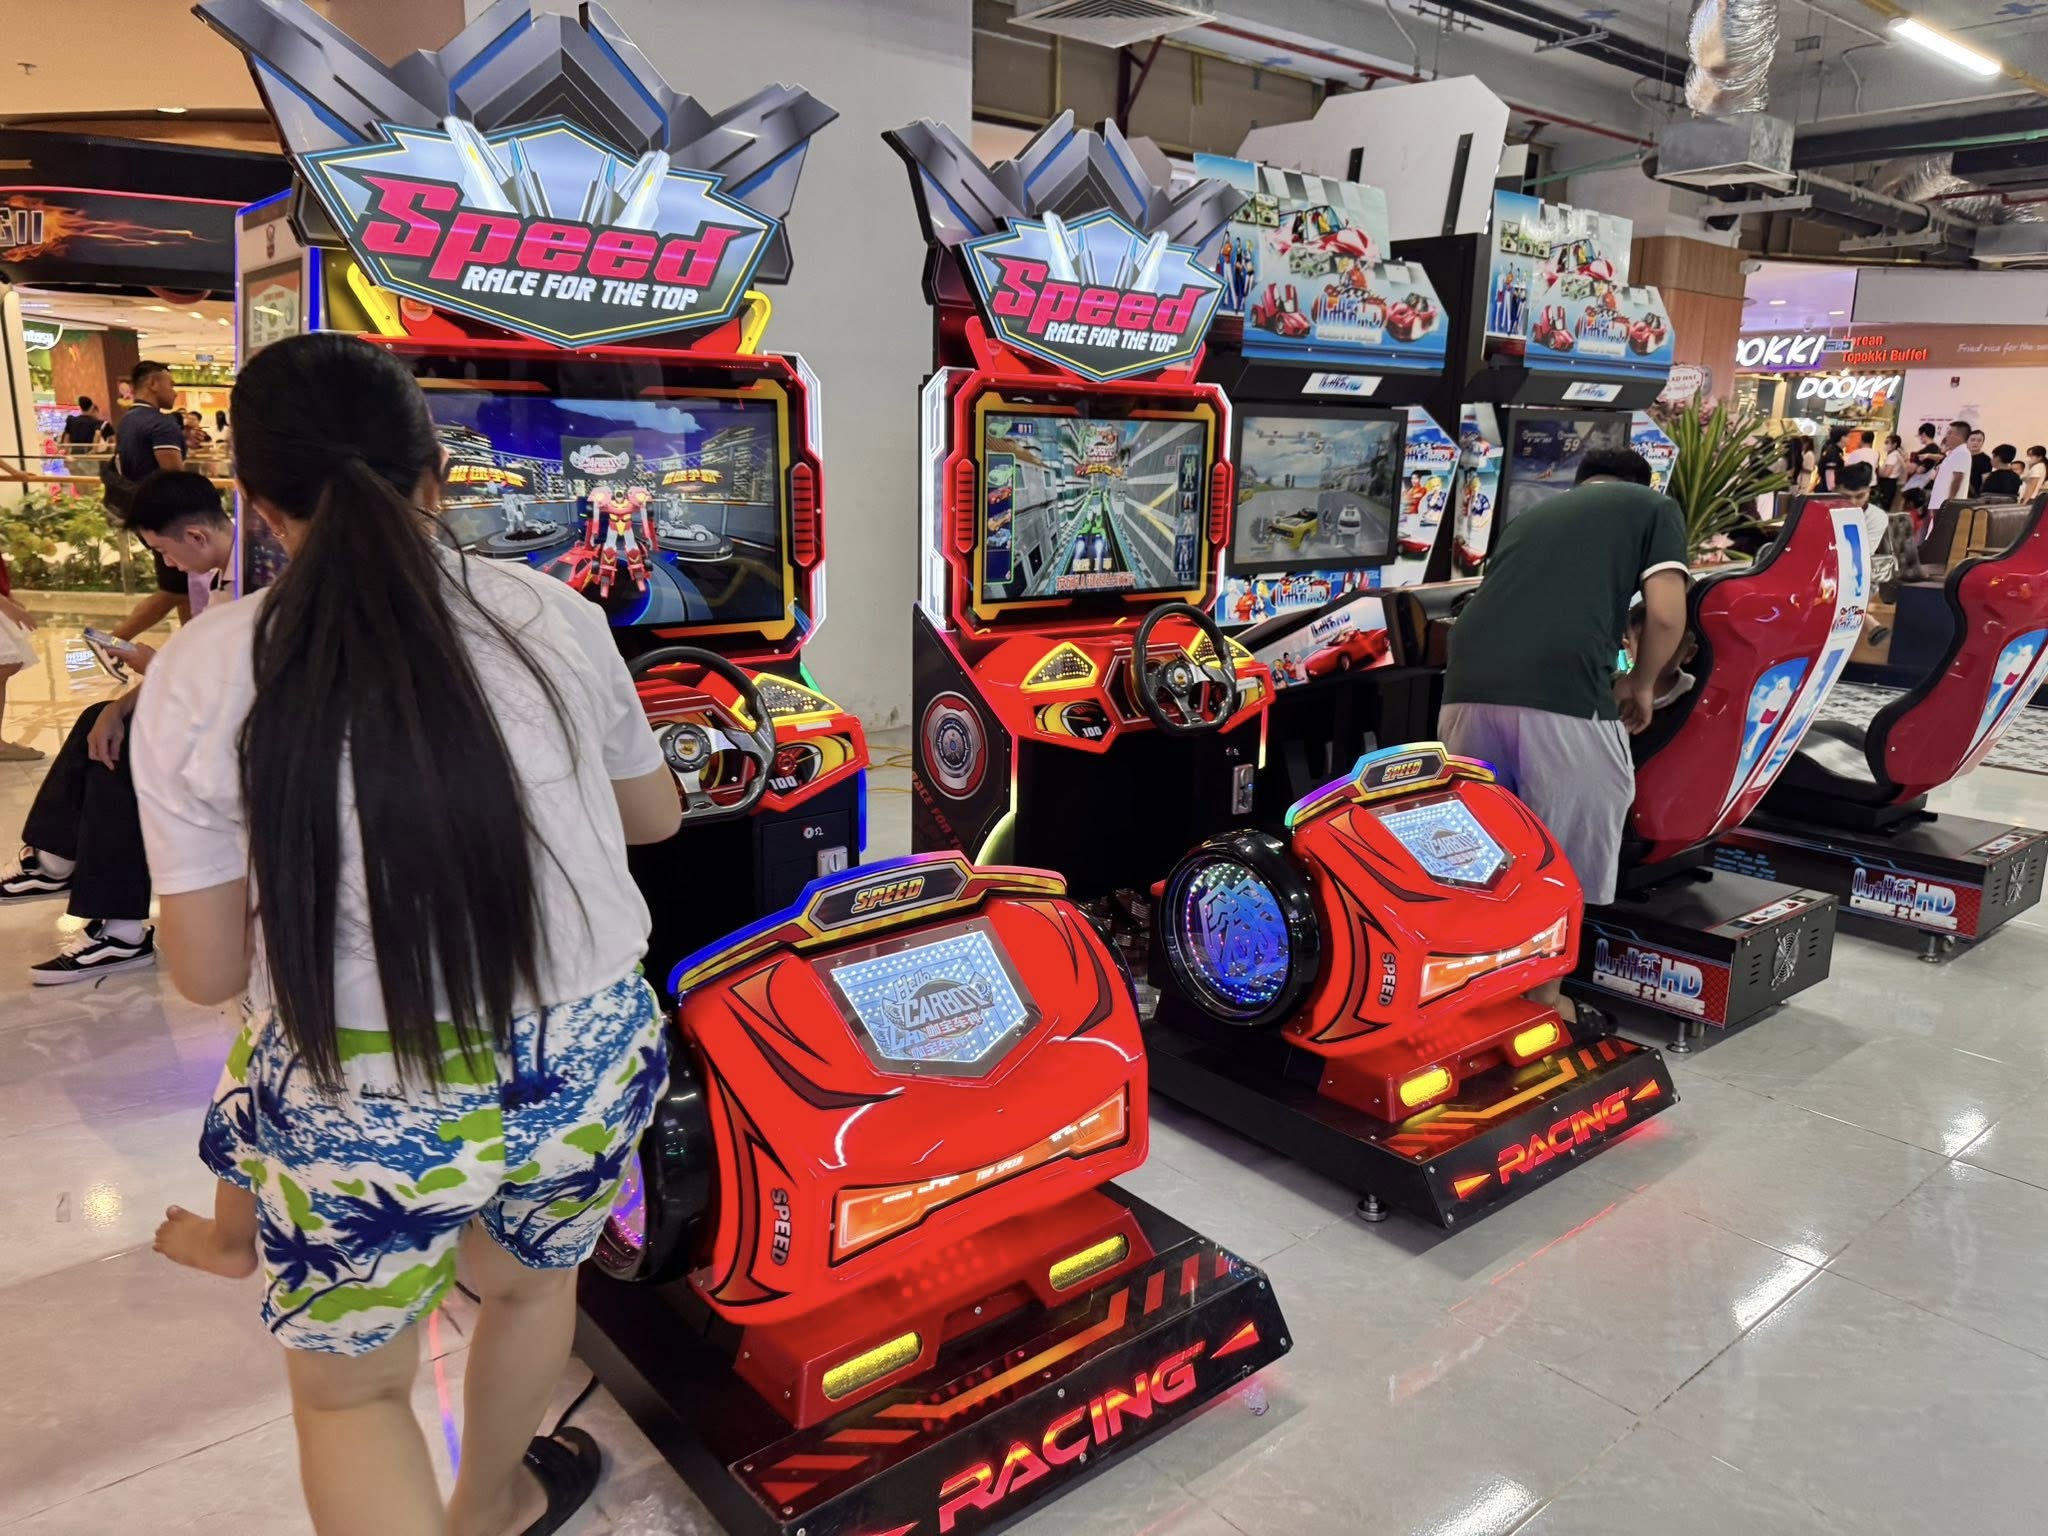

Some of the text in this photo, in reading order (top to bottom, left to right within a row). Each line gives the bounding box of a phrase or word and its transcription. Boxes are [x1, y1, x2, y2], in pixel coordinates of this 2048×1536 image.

[361, 175, 741, 286] Speed
[462, 266, 699, 312] RACE FOR THE TOP
[992, 257, 1206, 335] Speed
[1044, 321, 1178, 353] RACE FOR THE TOP
[1890, 348, 1928, 361] Buffet
[1796, 375, 1901, 400] DOOKKI
[1082, 726, 1103, 737] 100
[769, 776, 798, 790] 100
[1384, 759, 1424, 781] SPEED
[851, 876, 925, 915] SPEED
[1915, 881, 1957, 917] HD
[1378, 952, 1397, 1007] SPEED
[1661, 957, 1704, 998] HD
[904, 984, 994, 1029] CARBOT
[1498, 1087, 1630, 1185] RACING
[770, 1187, 791, 1266] SPEED
[938, 1340, 1205, 1534] RACING
